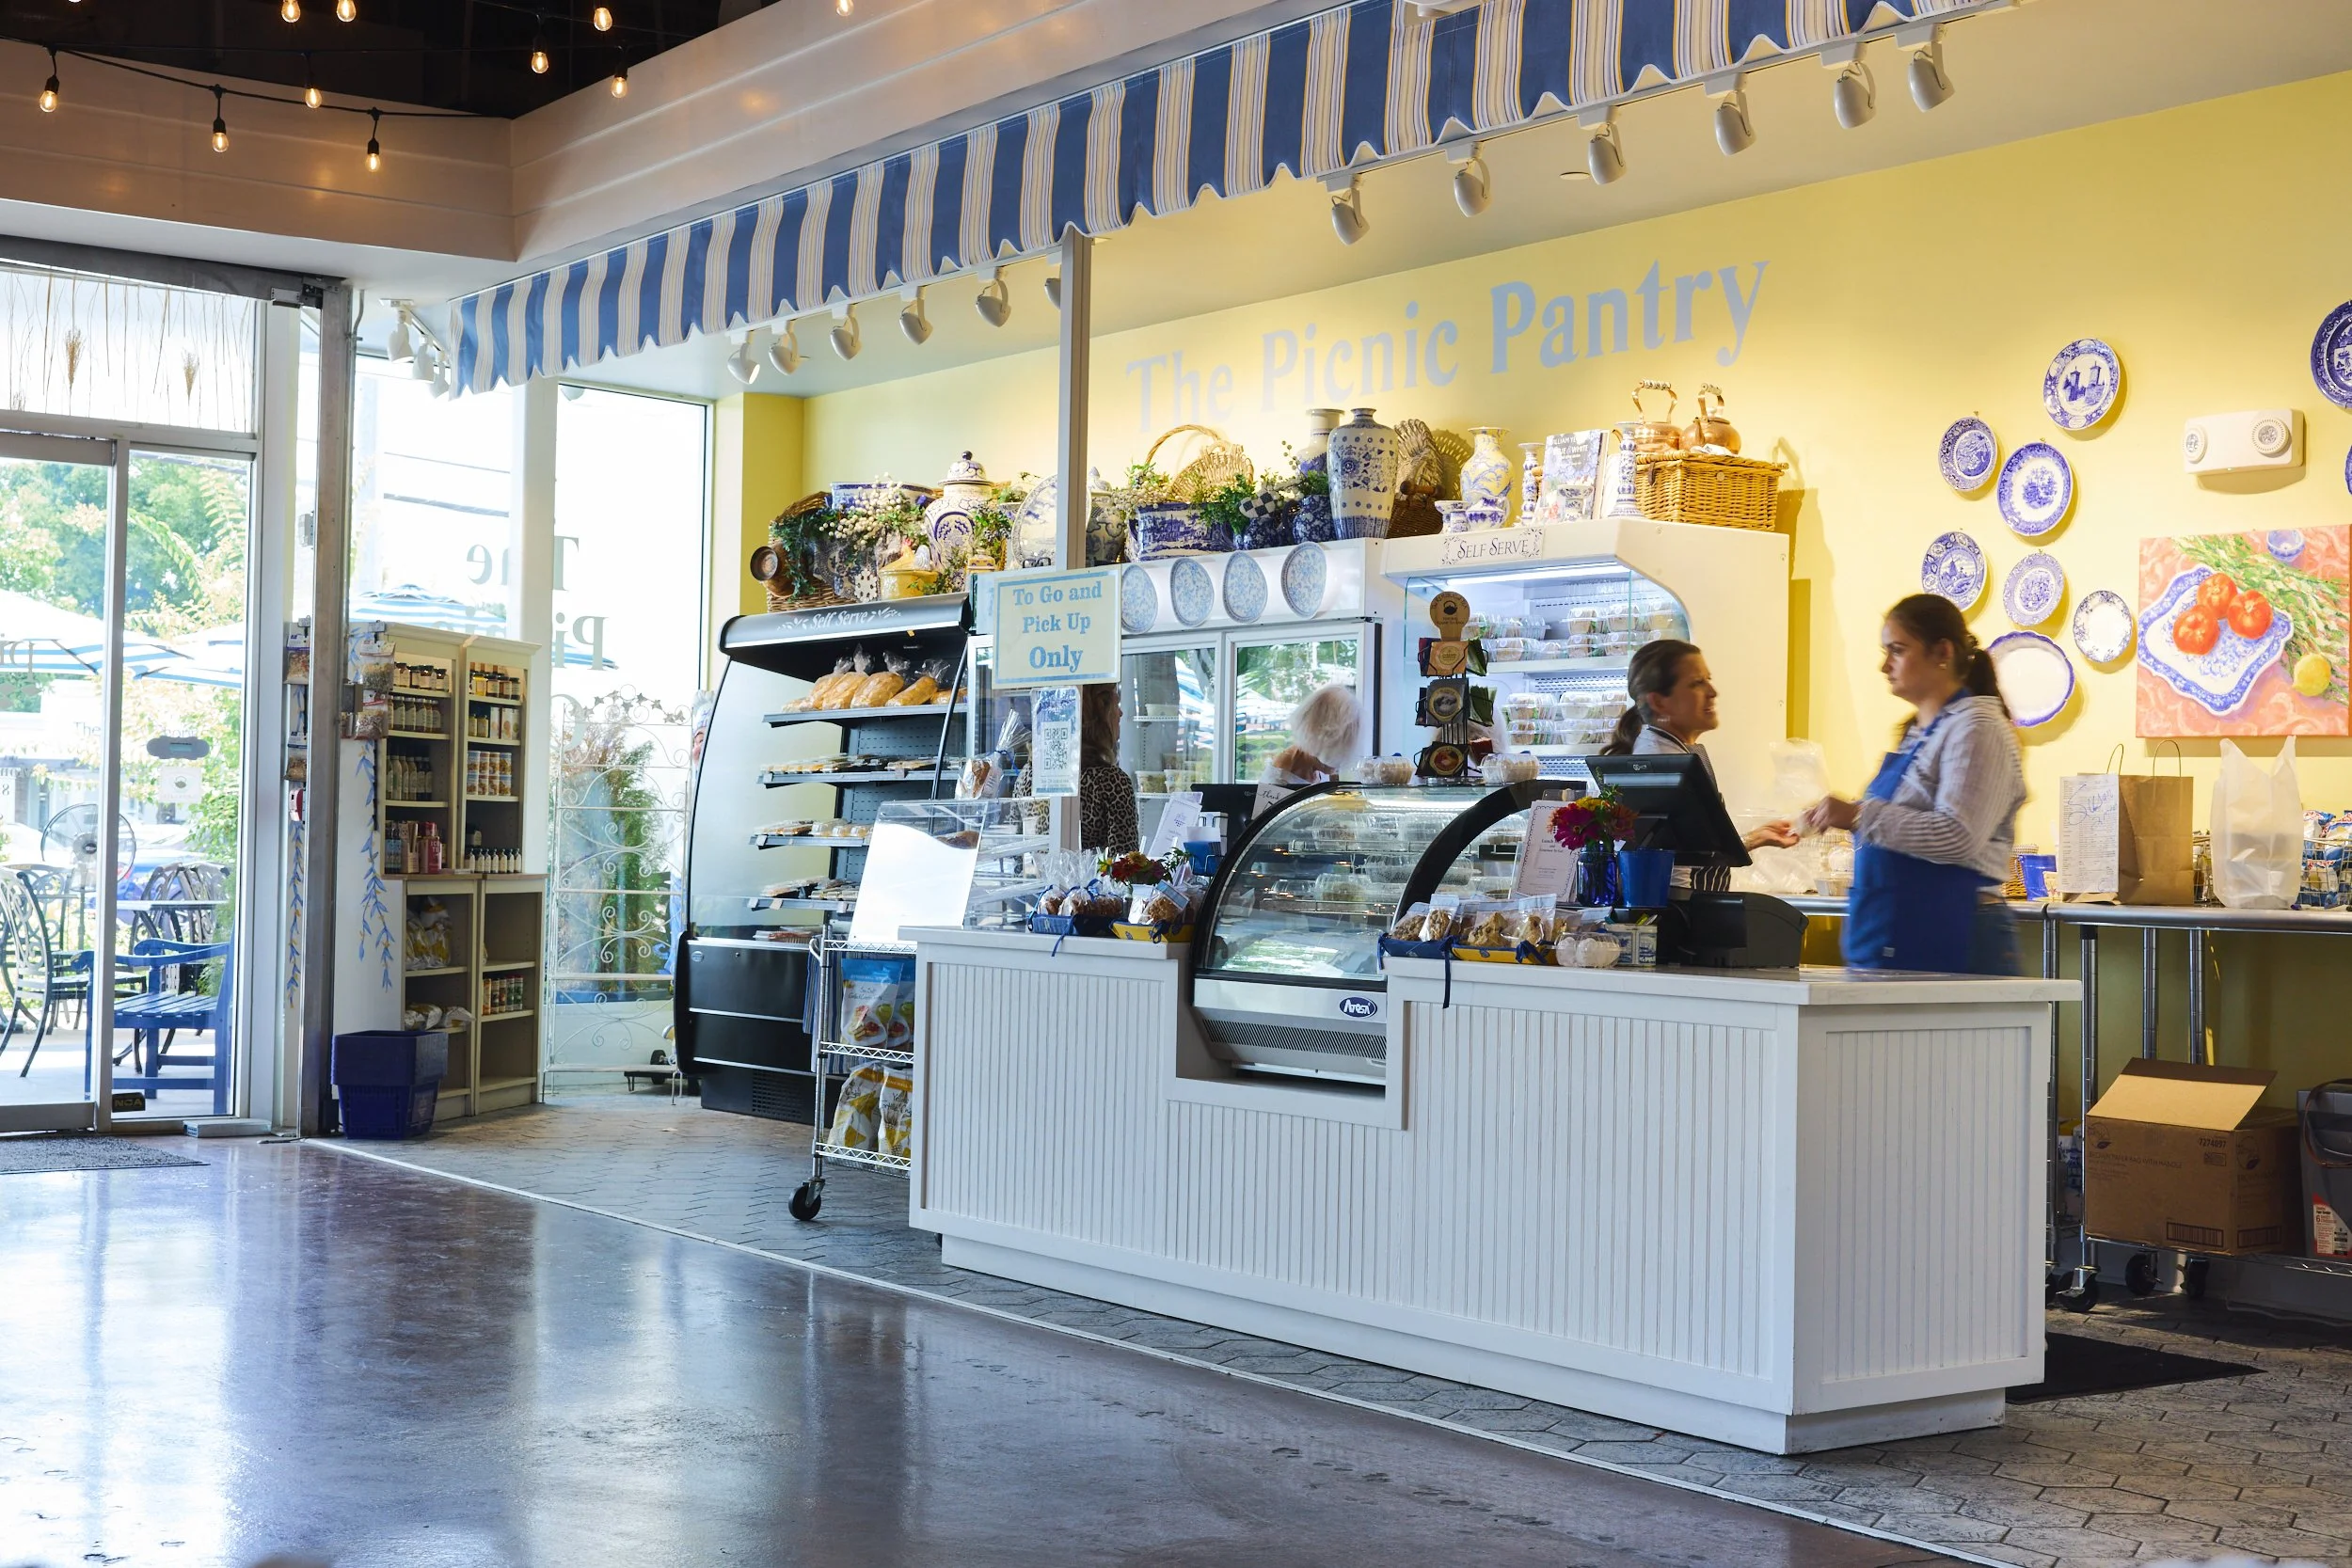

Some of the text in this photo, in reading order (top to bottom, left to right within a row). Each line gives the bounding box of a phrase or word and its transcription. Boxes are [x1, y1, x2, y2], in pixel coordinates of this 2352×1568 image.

[1126, 259, 1771, 433] The Picnic Pantry
[1456, 537, 1529, 560] SELF SERVE
[1012, 580, 1103, 606] To Go and
[810, 610, 868, 630] Self Serve
[1022, 612, 1091, 634] Pick Up
[1029, 644, 1083, 673] Only
